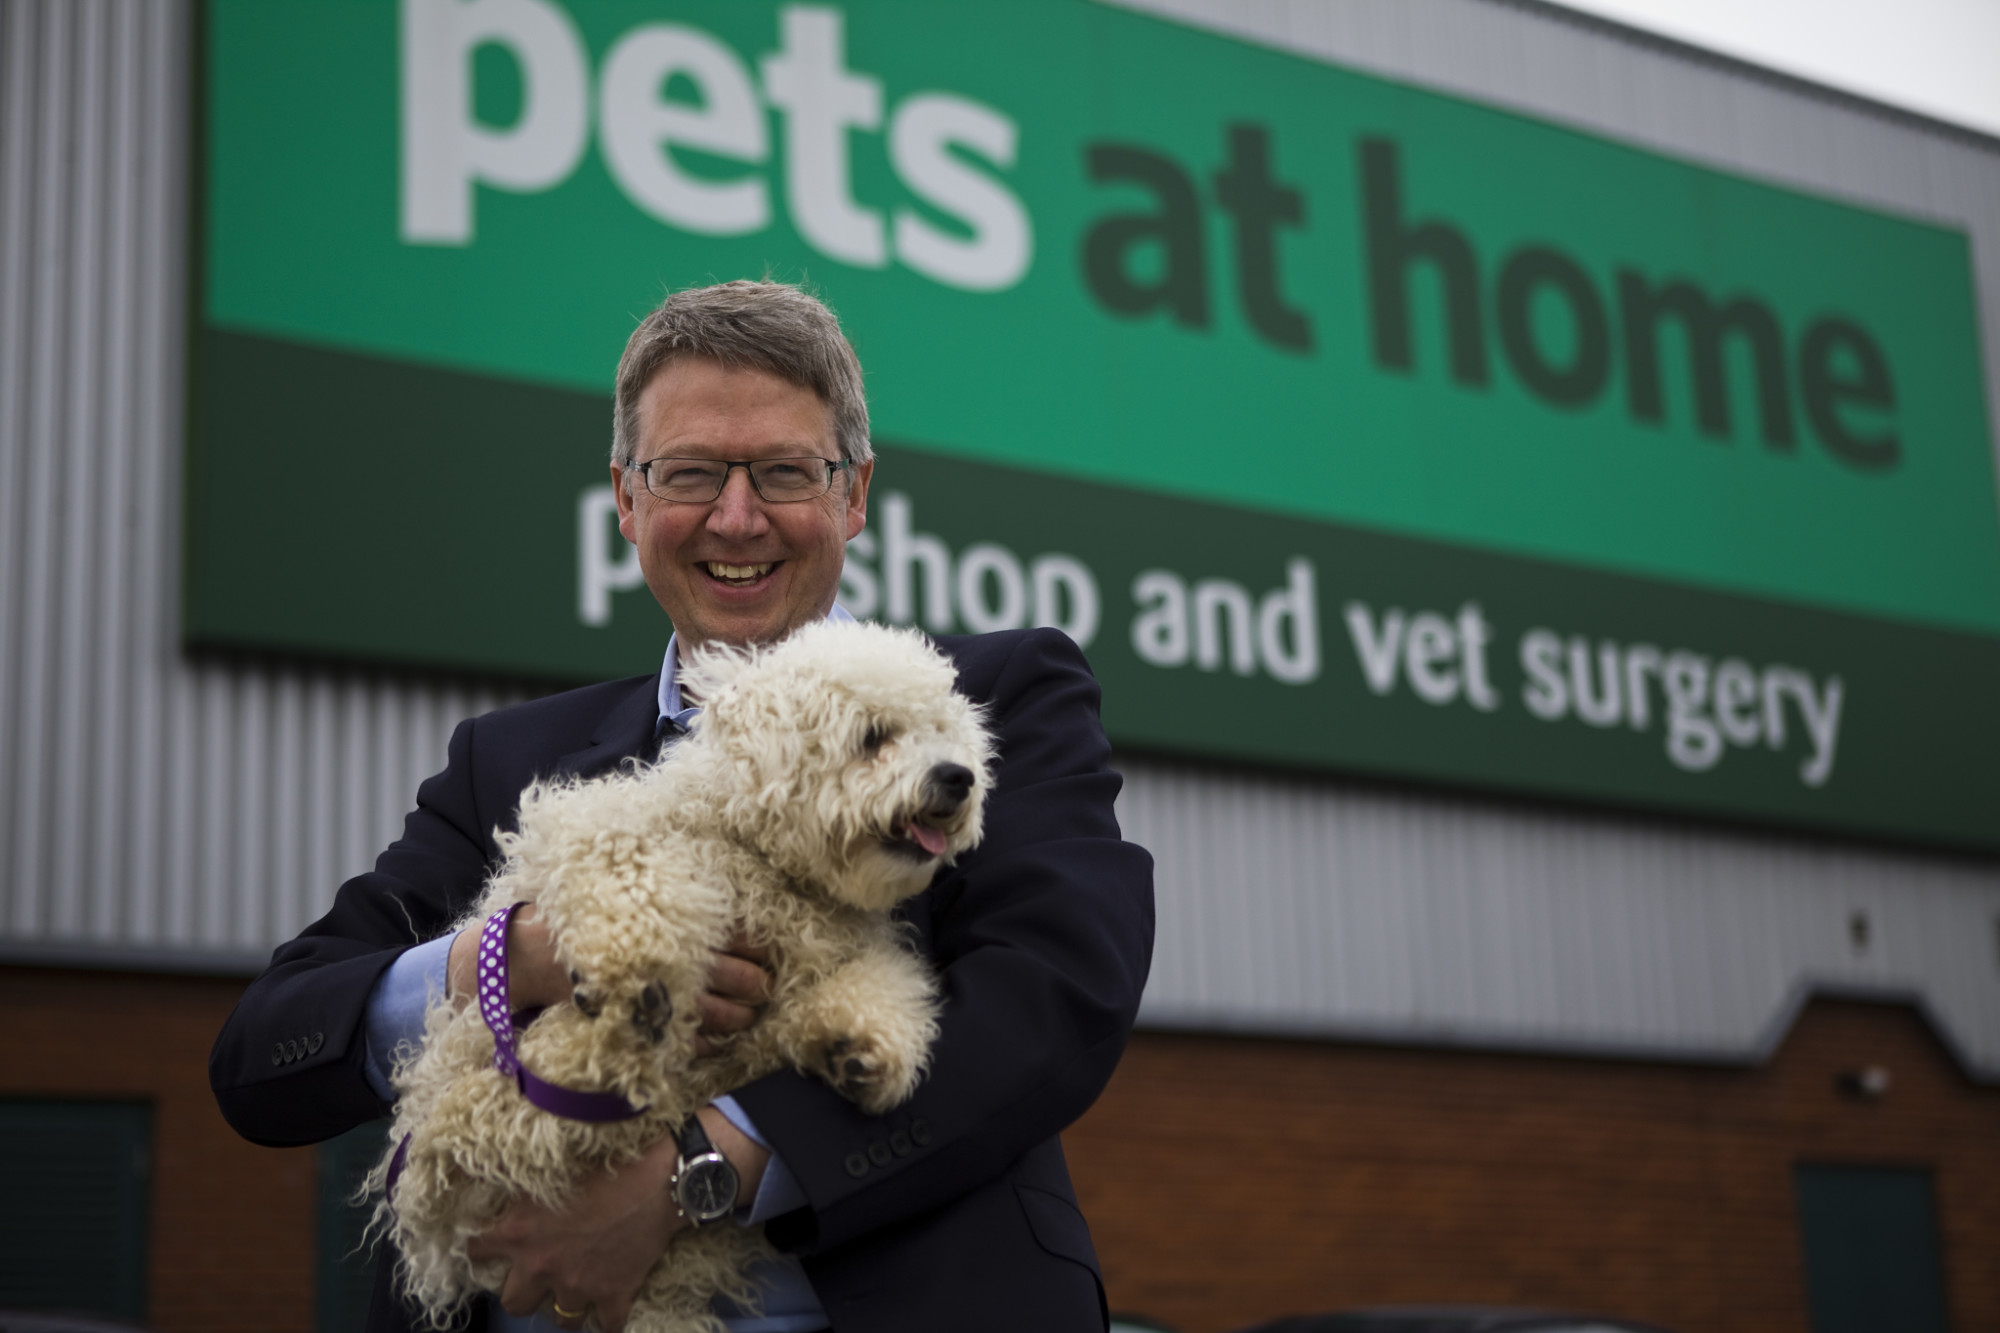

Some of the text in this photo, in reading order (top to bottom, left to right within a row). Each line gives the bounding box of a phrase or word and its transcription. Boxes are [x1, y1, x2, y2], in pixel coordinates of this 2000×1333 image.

[400, 0, 1903, 474] pets at home
[1131, 555, 1321, 686] and
[1345, 600, 1500, 711] vet
[1520, 627, 1844, 787] surgery
